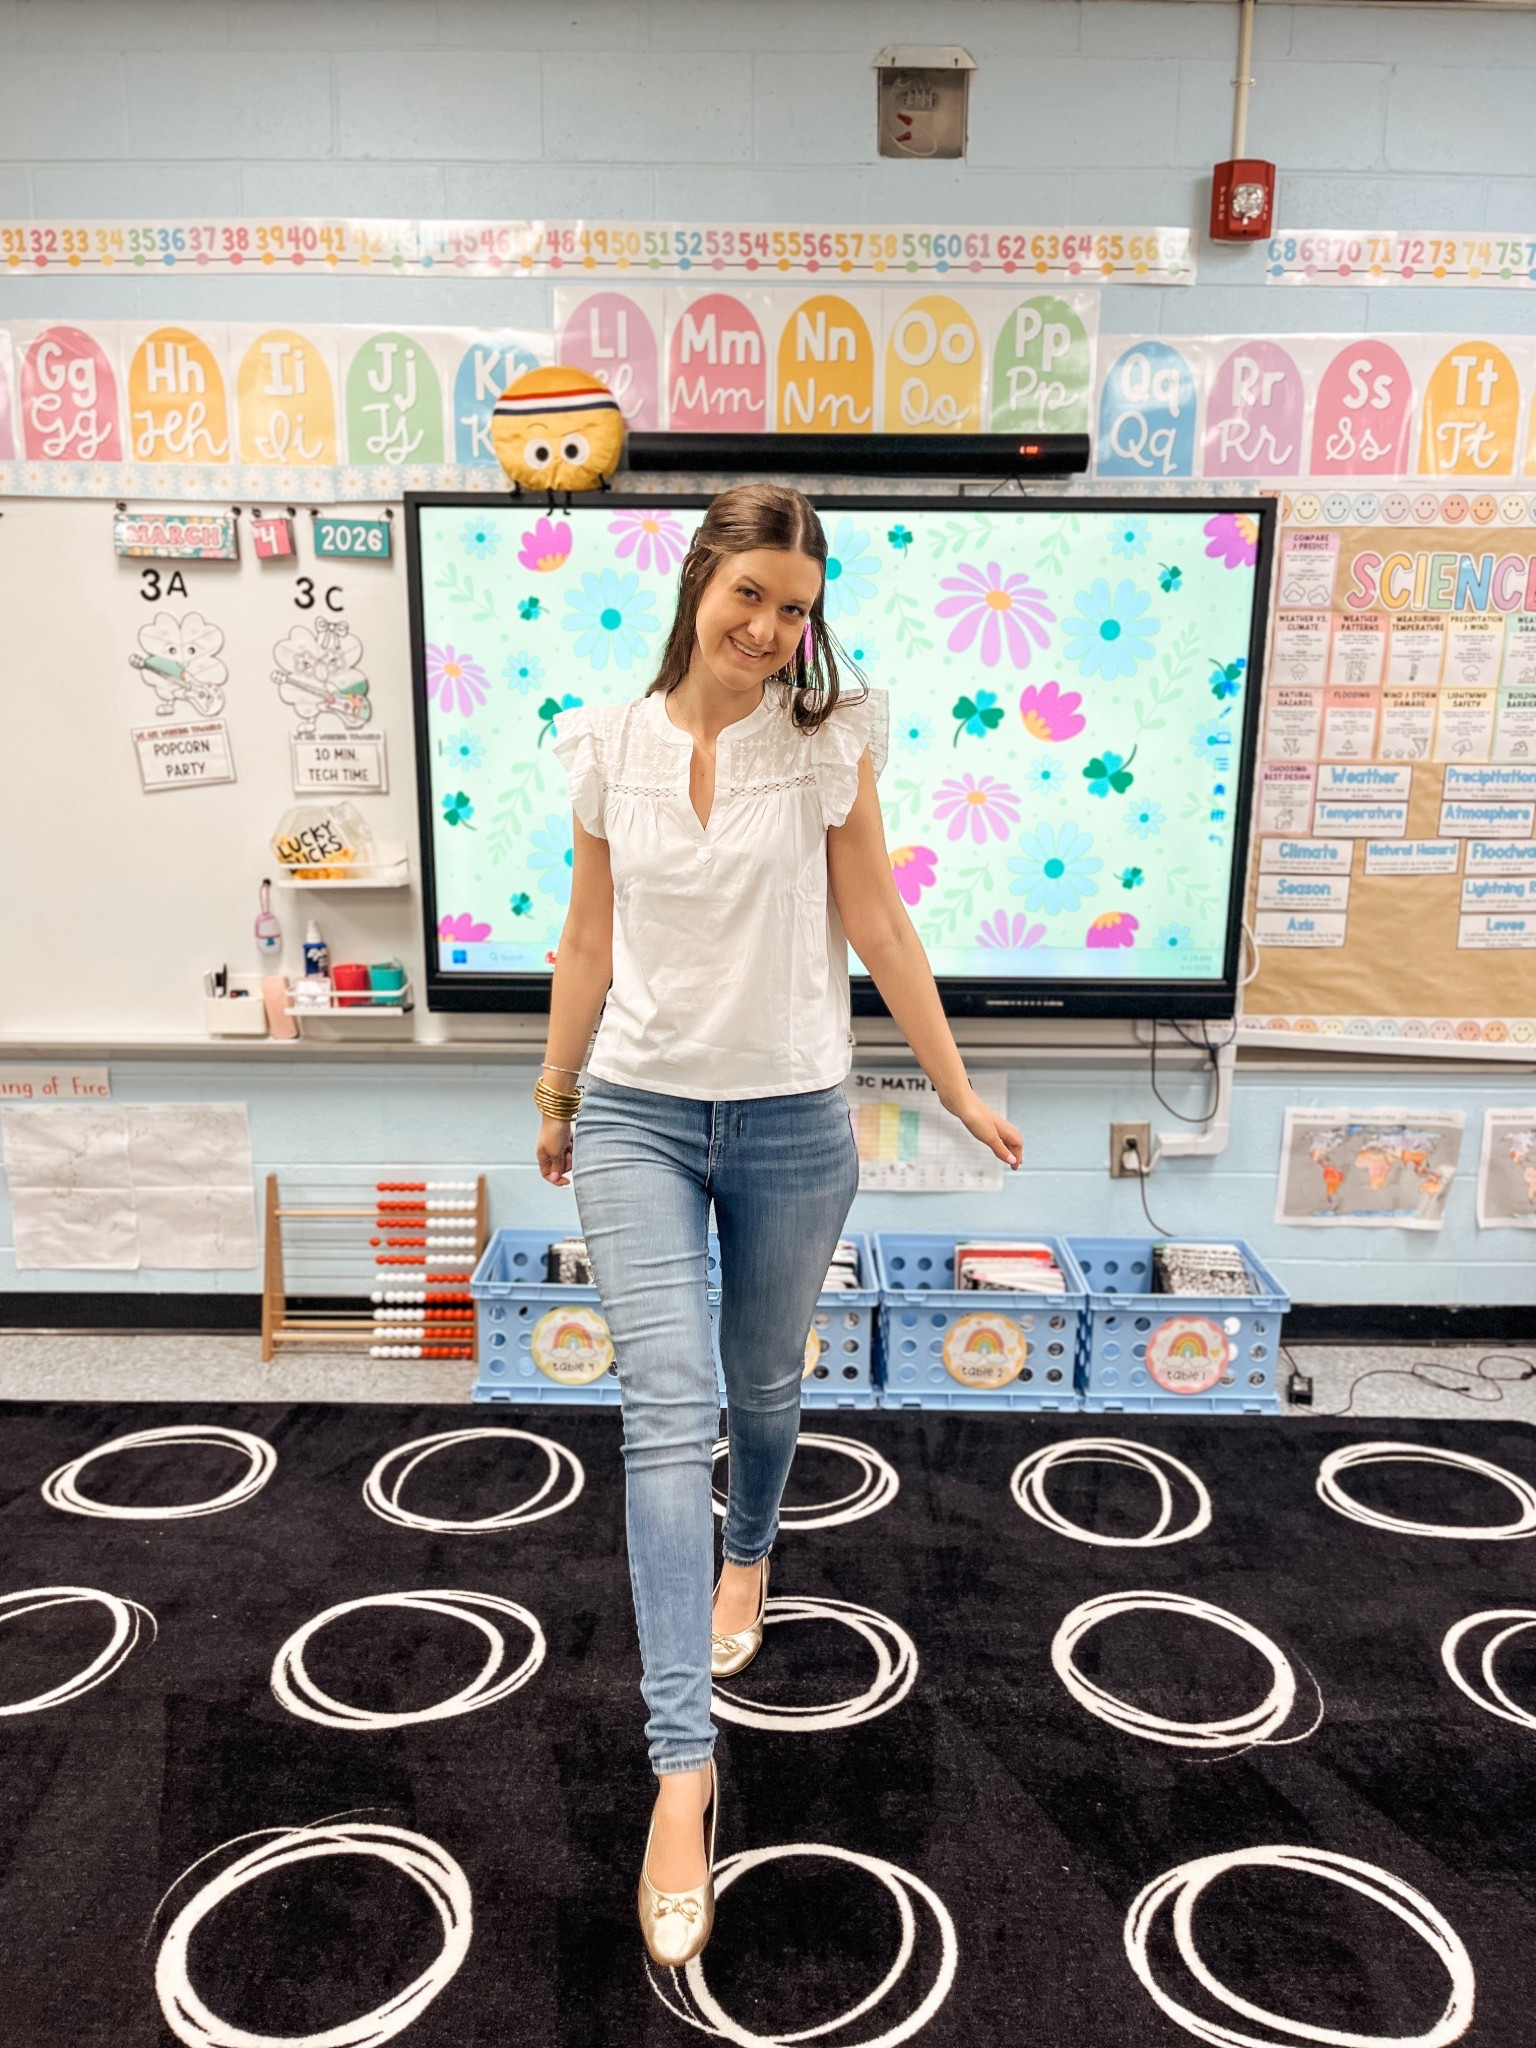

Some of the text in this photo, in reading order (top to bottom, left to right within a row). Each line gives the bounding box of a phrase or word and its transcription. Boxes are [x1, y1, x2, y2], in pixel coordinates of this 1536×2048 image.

[1, 229, 25, 252] 31
[30, 229, 57, 252] 32
[62, 229, 89, 252] 33
[96, 229, 123, 252] 34
[129, 229, 156, 252] 35
[157, 228, 185, 251] 36
[189, 227, 216, 250] 37
[222, 227, 249, 250] 38
[255, 227, 284, 250] 39
[287, 227, 317, 251] 40
[320, 226, 346, 251] 41
[353, 228, 382, 252] 42
[448, 230, 478, 253] 45
[480, 229, 510, 253] 46
[546, 231, 575, 254] 48
[580, 231, 609, 254] 49
[611, 231, 641, 255] 50
[644, 232, 670, 255] 51
[675, 232, 703, 256] 52
[706, 232, 735, 256] 53
[739, 233, 769, 257] 54
[773, 233, 802, 257] 55
[803, 234, 832, 258] 56
[835, 234, 864, 258] 57
[869, 234, 898, 258] 58
[902, 234, 932, 258] 59
[933, 234, 962, 258] 60
[965, 234, 990, 259] 61
[997, 235, 1026, 260] 62
[1031, 235, 1060, 260] 63
[1062, 235, 1093, 260] 64
[1095, 236, 1124, 260] 65
[1129, 236, 1158, 260] 66
[1268, 238, 1297, 262] 68
[1300, 238, 1330, 262] 69
[1334, 239, 1361, 263] 70
[1367, 239, 1391, 263] 71
[1399, 240, 1424, 264] 72
[1429, 241, 1456, 265] 73
[1462, 241, 1491, 265] 74
[1496, 242, 1523, 266] 75
[590, 307, 628, 359] Ll
[681, 313, 761, 365] Mm
[796, 311, 856, 362] Nn
[894, 309, 975, 366] Oo
[1016, 307, 1072, 372] Pp
[36, 342, 97, 408] Gg
[145, 342, 205, 395] Hh
[261, 342, 306, 397] Ii
[367, 342, 417, 409] Jj
[1120, 352, 1181, 418] Qq
[1231, 356, 1286, 407] Rr
[1343, 359, 1394, 410] Ss
[1451, 355, 1499, 407] Tt
[671, 375, 764, 415] Mm
[782, 378, 872, 428] Nn
[900, 377, 970, 427] Oo
[1005, 365, 1079, 429] Pp
[31, 393, 112, 460] Gg
[134, 401, 228, 453] Hh
[254, 411, 323, 461] Ii
[361, 403, 424, 464] Jj
[1110, 410, 1177, 475] Qq
[1216, 418, 1293, 466] Rr
[1325, 416, 1392, 462] Ss
[1437, 421, 1499, 469] Tt
[126, 525, 221, 547] MARCH
[261, 525, 279, 555] 4
[321, 525, 383, 551] 2026
[1293, 534, 1330, 542] COMPARE
[1299, 542, 1329, 550] PREDICT
[140, 568, 188, 601] 3A
[1277, 699, 1313, 707] HAZARDS
[1334, 691, 1371, 699] FLOODING
[1453, 700, 1481, 708] SAFETY
[153, 739, 210, 756] POPCORN
[315, 748, 330, 761] 10
[166, 762, 205, 777] PARTY
[309, 768, 369, 782] TECH TIME
[1331, 767, 1400, 784] Weather
[1318, 804, 1404, 823] Temperature
[1445, 804, 1531, 823] Atmosphere
[277, 820, 332, 859] LUCKY
[1279, 842, 1338, 859] Climate
[1369, 843, 1457, 857] Natural Hazard
[1276, 879, 1331, 895] Season
[1465, 881, 1525, 898] Lightning
[1287, 917, 1315, 931] Axis
[1486, 918, 1525, 931] Levee
[42, 1076, 58, 1095] of
[72, 1076, 108, 1096] Fire
[856, 1076, 876, 1088] 3C
[881, 1077, 926, 1091] MATH
[553, 1362, 584, 1372] table
[962, 1366, 993, 1376] table
[1167, 1370, 1199, 1381] table
